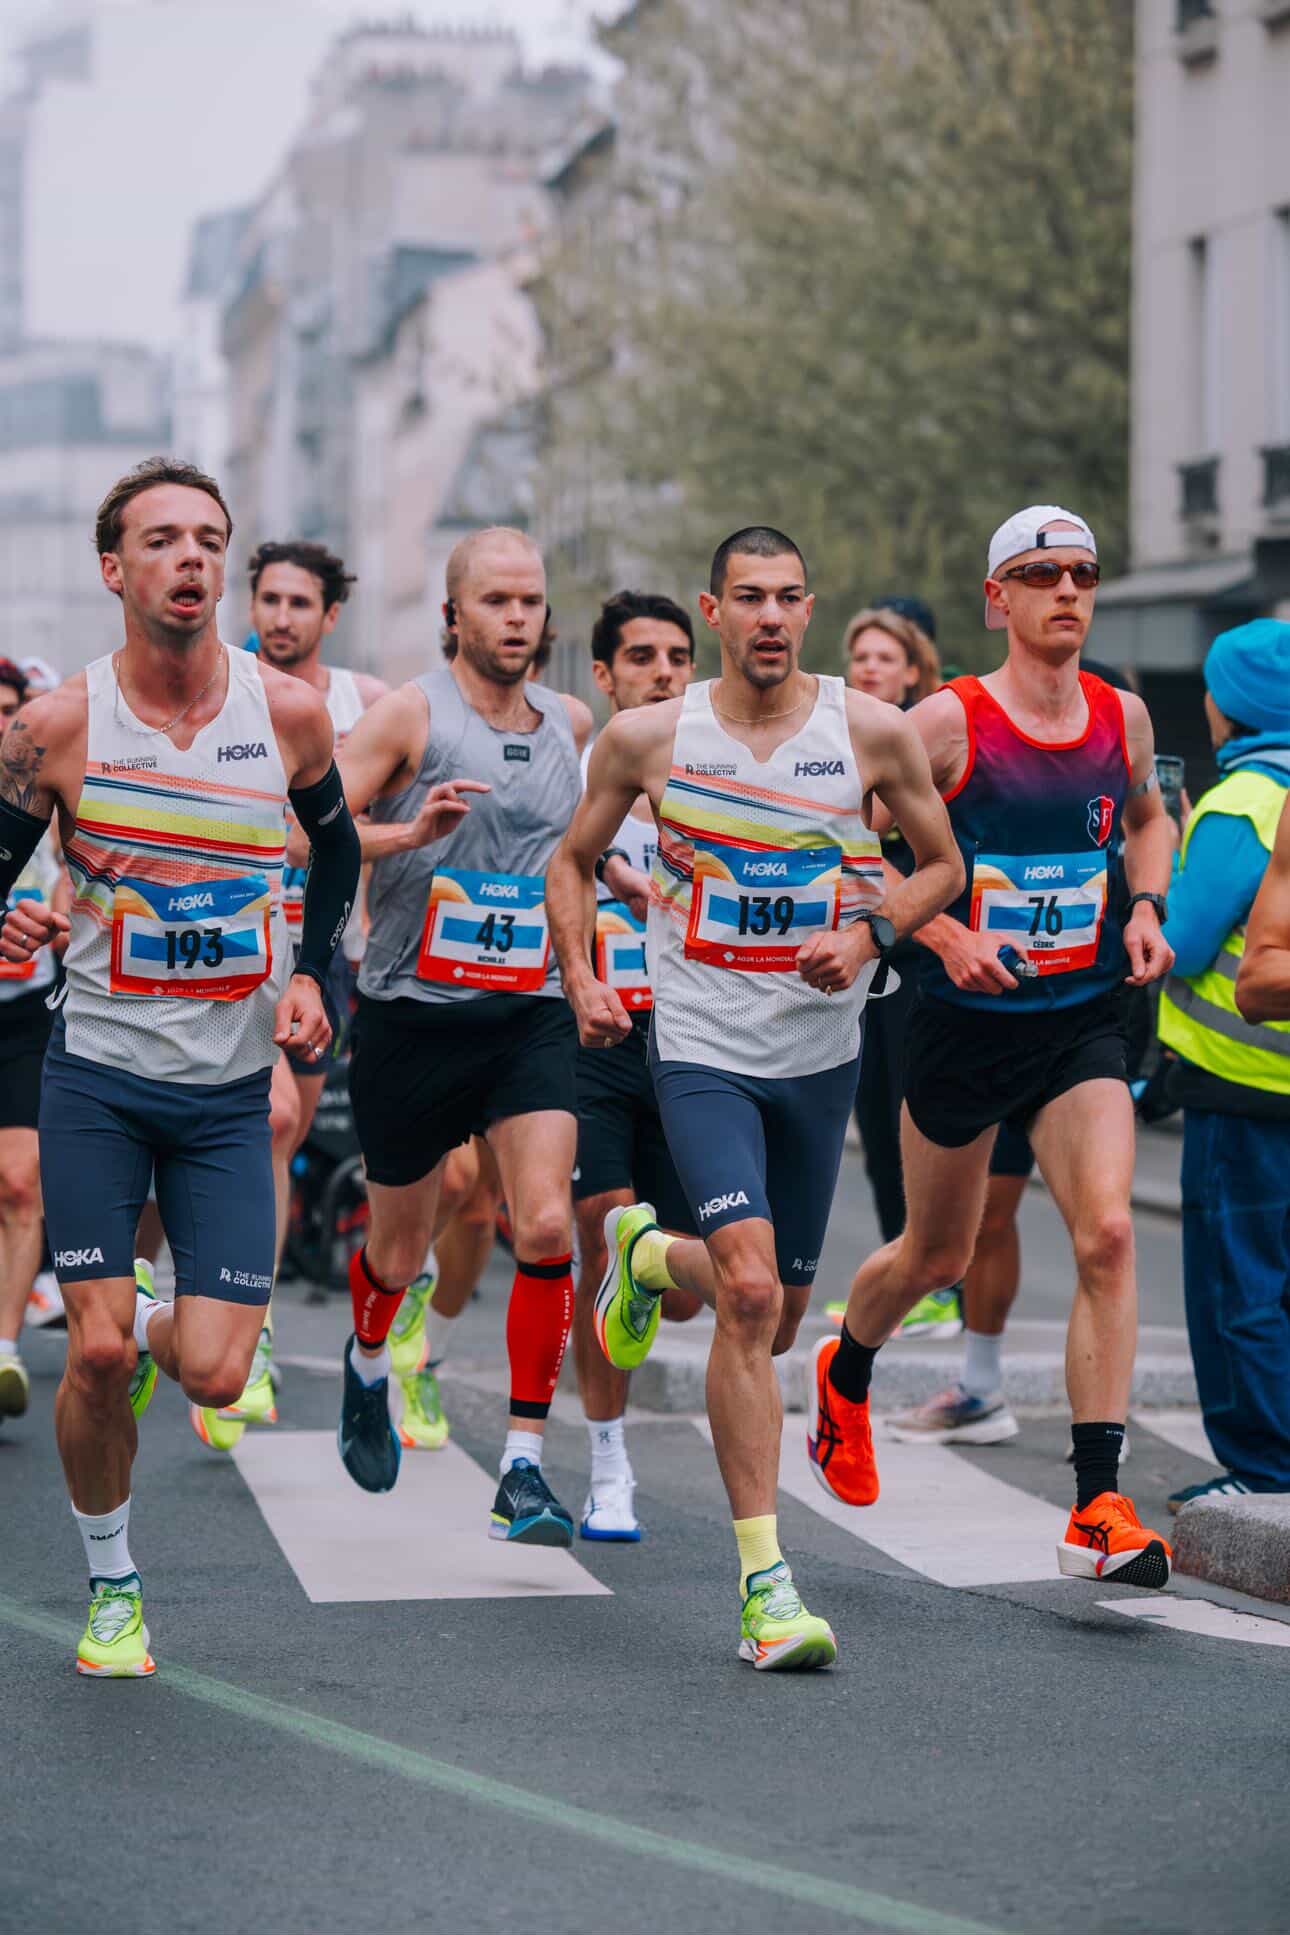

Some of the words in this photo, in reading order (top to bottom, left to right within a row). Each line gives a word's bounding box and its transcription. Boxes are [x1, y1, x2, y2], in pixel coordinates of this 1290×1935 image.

[217, 743, 268, 763] HOKA
[113, 761, 158, 773] COLLECTIVE
[695, 768, 737, 776] COLLECTIVE
[794, 760, 845, 777] HOKA
[743, 862, 788, 877] HOKA
[1024, 865, 1065, 881] HOKA
[479, 882, 520, 899] HOKA
[168, 892, 216, 912] HOKA
[738, 894, 795, 936] 139
[1028, 895, 1063, 937] 76
[476, 912, 516, 953] 43
[165, 927, 224, 970] 193
[766, 955, 796, 963] MONDIAL
[698, 1190, 750, 1222] HOKA
[54, 1247, 105, 1268] HOKA
